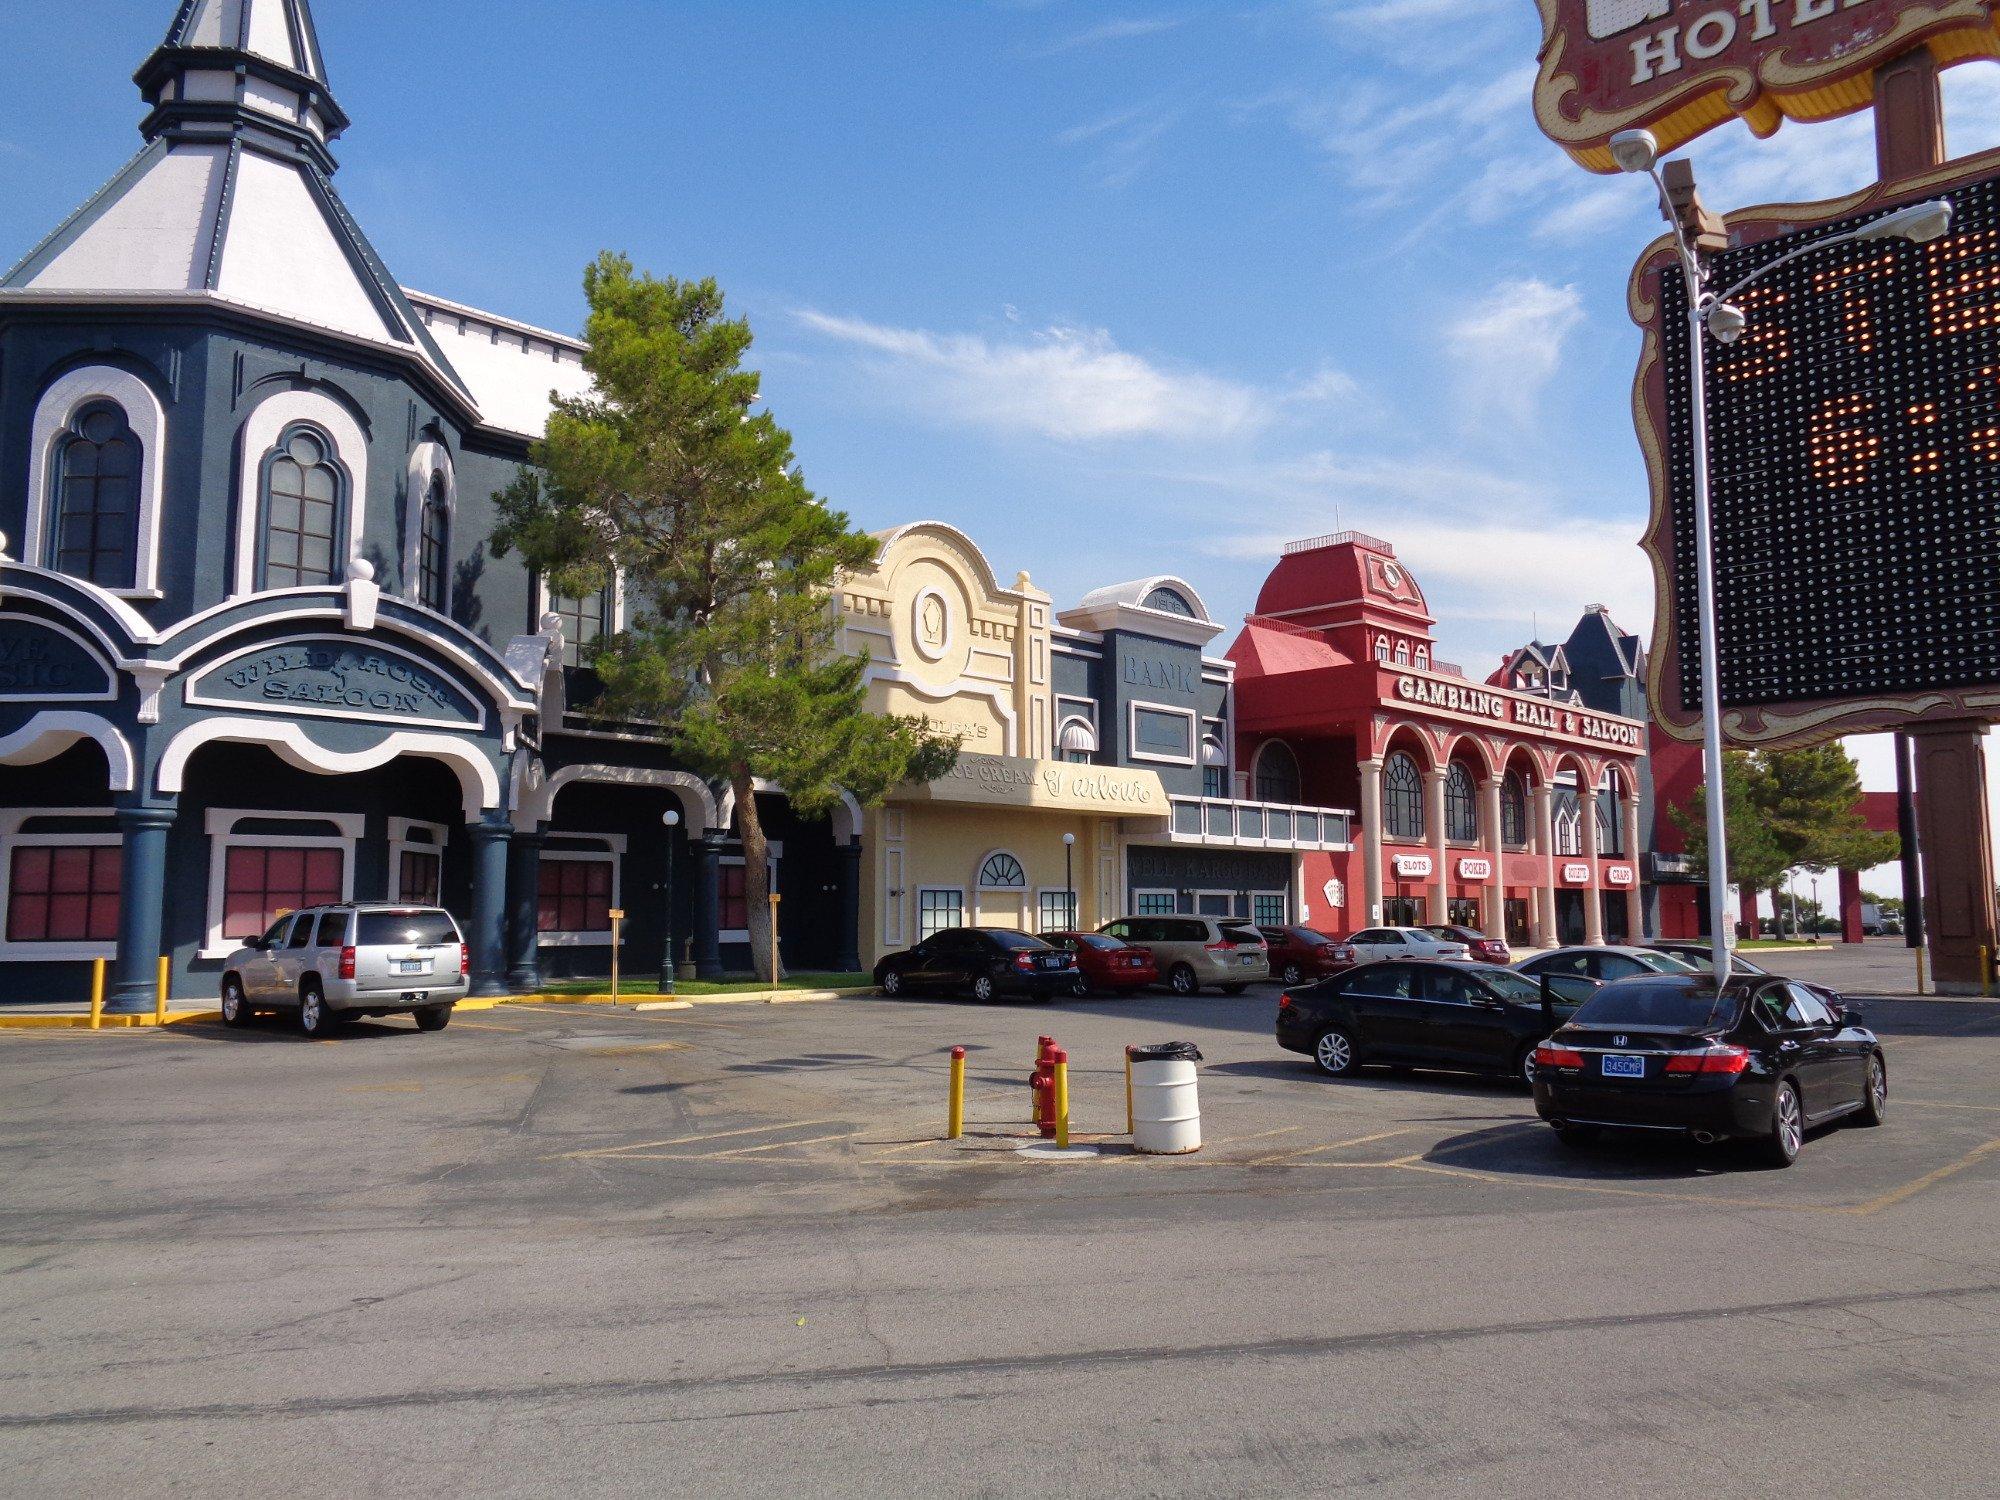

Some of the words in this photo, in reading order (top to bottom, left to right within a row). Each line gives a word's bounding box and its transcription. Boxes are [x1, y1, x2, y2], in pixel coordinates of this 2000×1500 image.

[225, 649, 332, 688] WILD
[1122, 654, 1195, 694] BANK
[262, 679, 422, 712] SALOON
[1398, 675, 1504, 718] GAMBLING
[1515, 700, 1559, 729] HALL
[1565, 712, 1576, 732] &
[1583, 717, 1639, 745] SALOON
[978, 766, 1039, 786] CREAM
[1403, 860, 1427, 871] SLOTS
[1464, 862, 1487, 875] POKER
[1612, 869, 1630, 880] CRAPS
